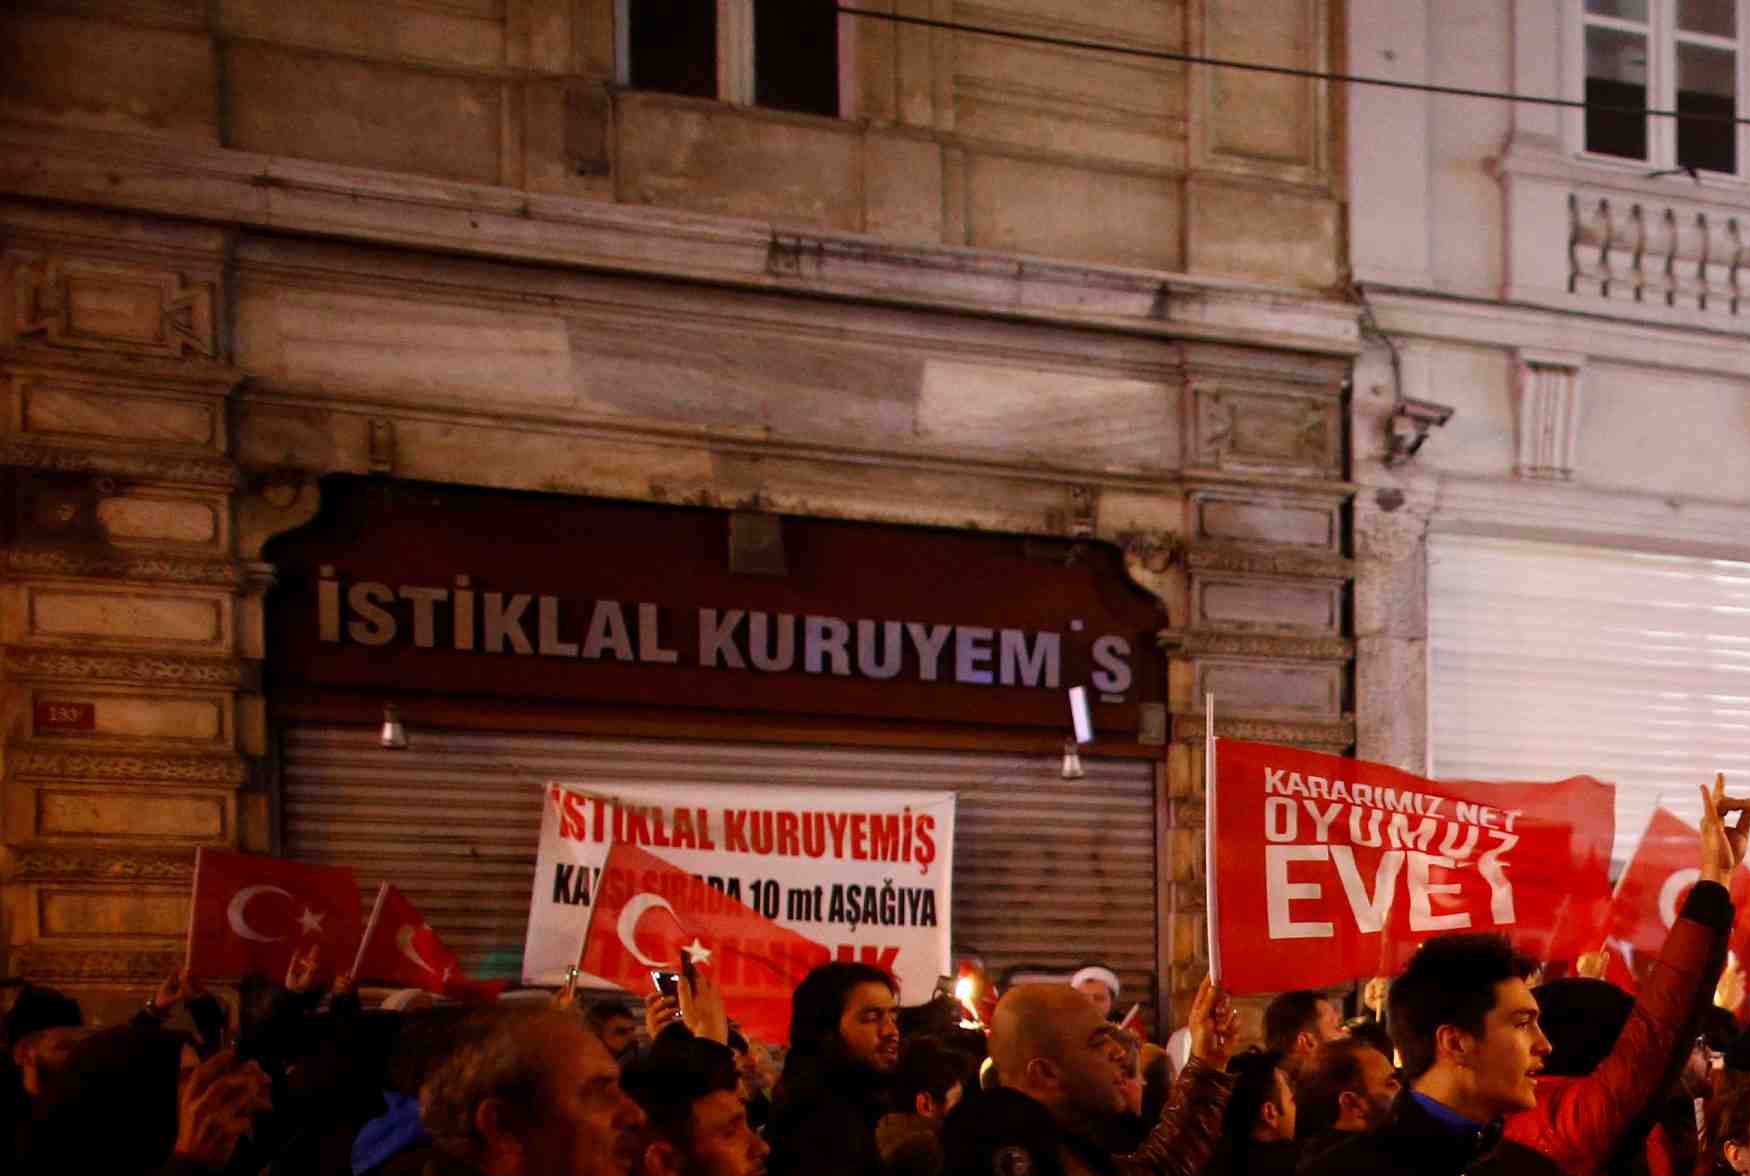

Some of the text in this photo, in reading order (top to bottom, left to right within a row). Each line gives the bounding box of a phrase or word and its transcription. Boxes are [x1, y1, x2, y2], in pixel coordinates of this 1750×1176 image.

[317, 564, 1133, 703] İSTİKLAL KURUYEMŞ
[1264, 767, 1446, 819] KARARIMIZ
[723, 805, 937, 876] KURUYEMİŞ
[1264, 796, 1520, 864] OYUMUZ
[750, 880, 780, 920] 10
[787, 885, 824, 922] mt
[828, 877, 938, 933] AŞAĞIYA
[1265, 844, 1517, 939] EVET
